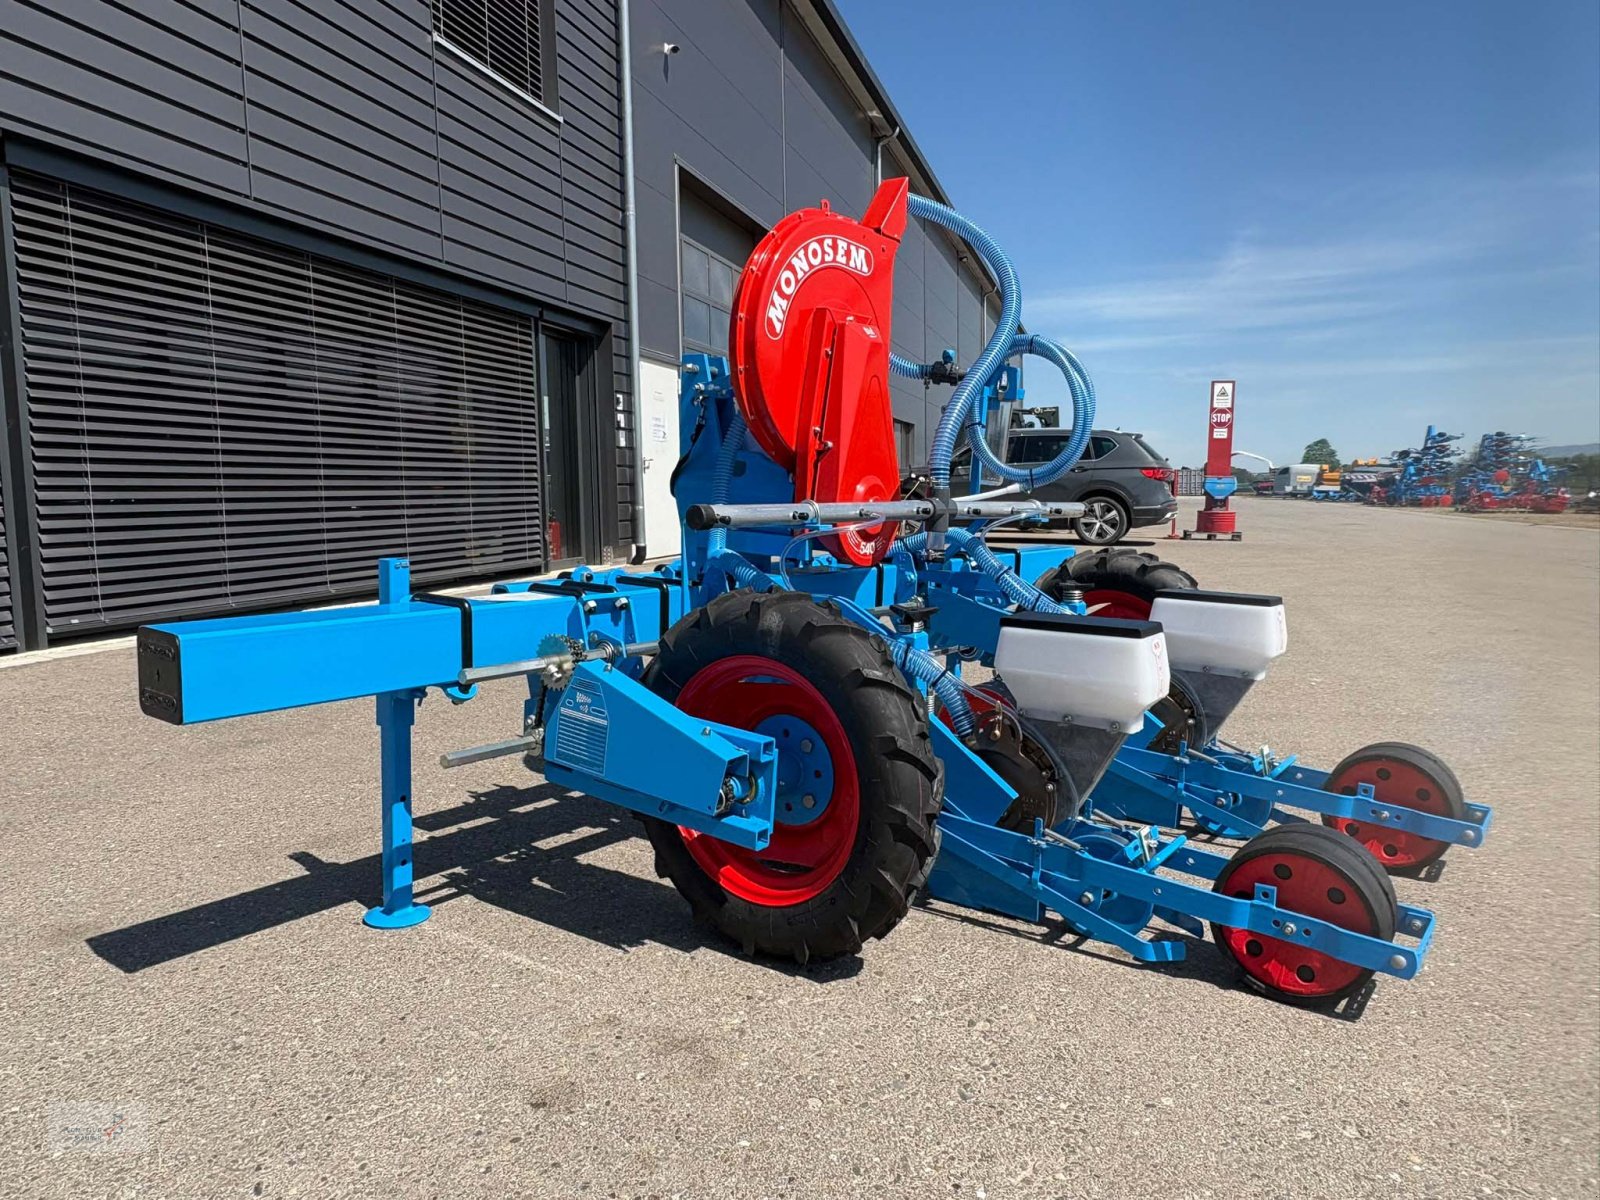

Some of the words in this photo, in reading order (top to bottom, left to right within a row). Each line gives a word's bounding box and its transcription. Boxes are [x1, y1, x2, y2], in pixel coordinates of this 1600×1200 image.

[767, 238, 869, 334] MONOSEM
[1212, 413, 1231, 423] STOP
[860, 541, 876, 556] 540
